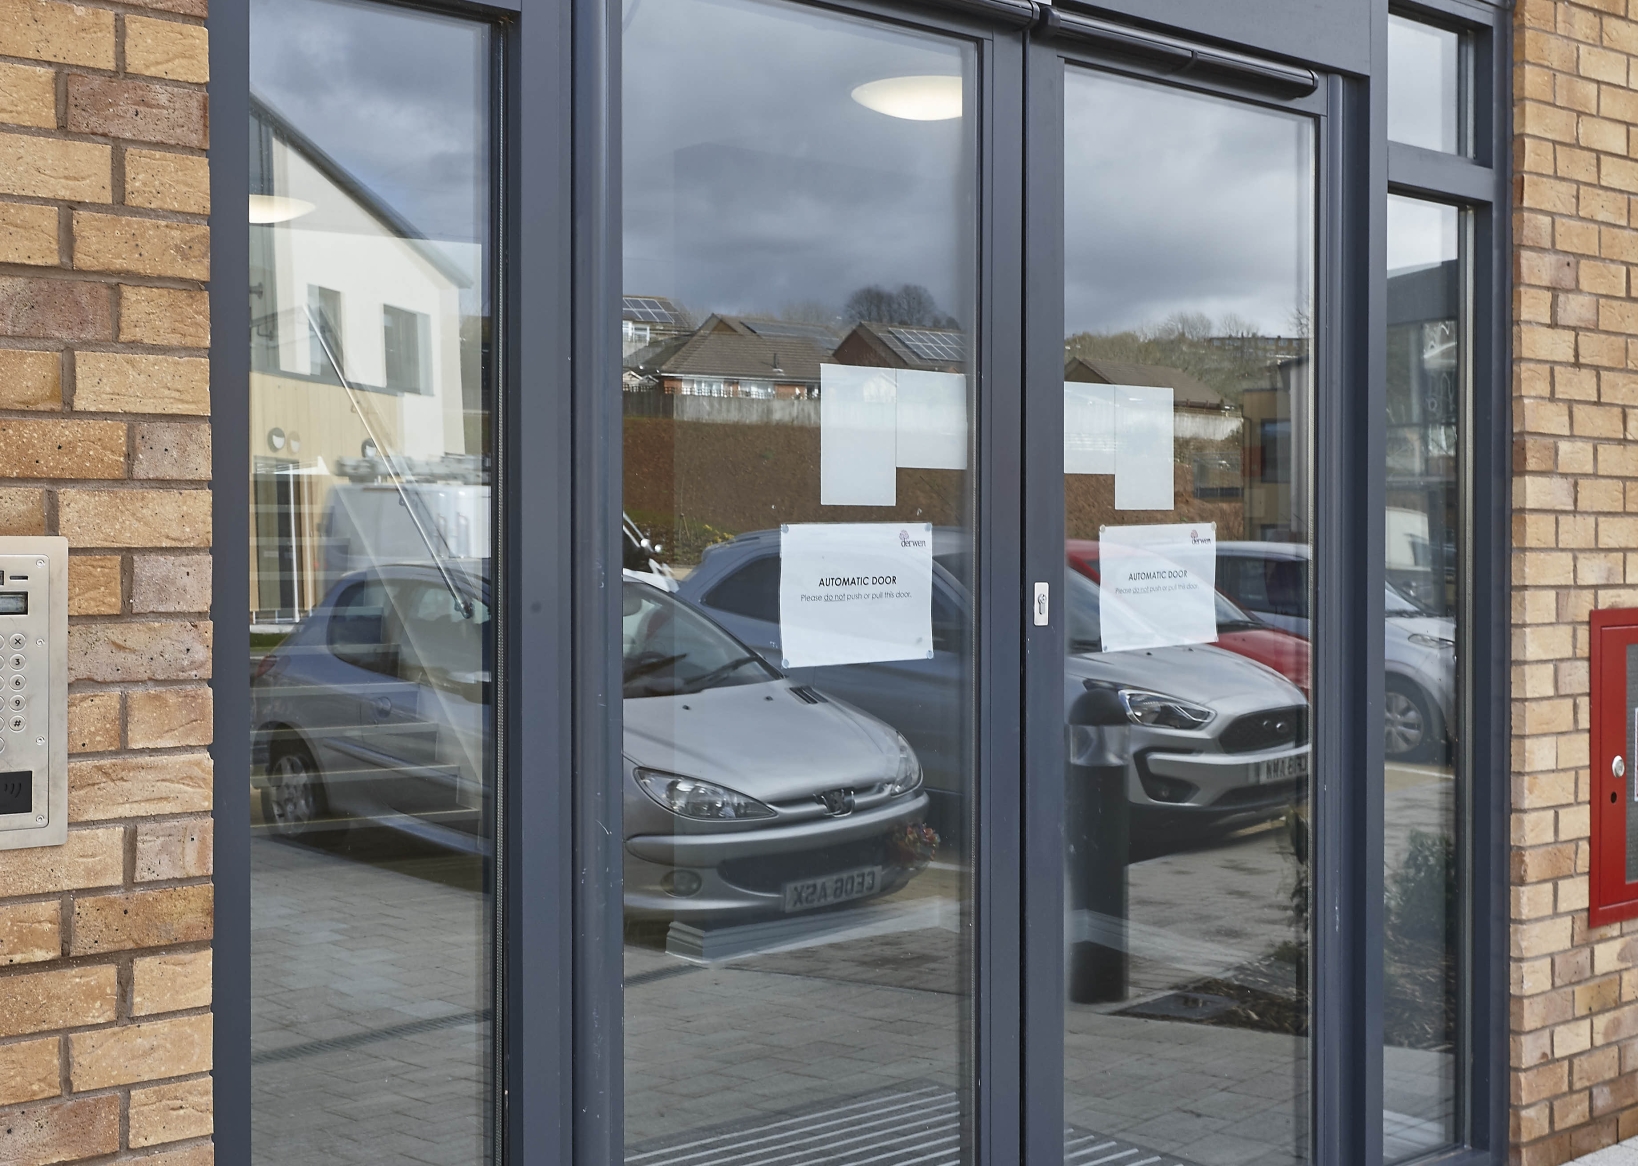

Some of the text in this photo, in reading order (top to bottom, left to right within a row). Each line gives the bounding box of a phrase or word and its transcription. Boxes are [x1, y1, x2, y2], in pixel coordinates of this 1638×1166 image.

[900, 537, 926, 547] derwen
[1128, 569, 1188, 581] AUTOMATIC DOOR
[818, 575, 897, 587] AUTOMATIC DOOR
[800, 593, 823, 602] Please
[823, 593, 834, 602] do
[834, 593, 846, 602] not
[846, 591, 863, 601] push
[871, 591, 883, 601] pull
[884, 590, 895, 599] this
[895, 590, 912, 599] door.
[15, 658, 20, 666] 3
[15, 699, 20, 707] 9
